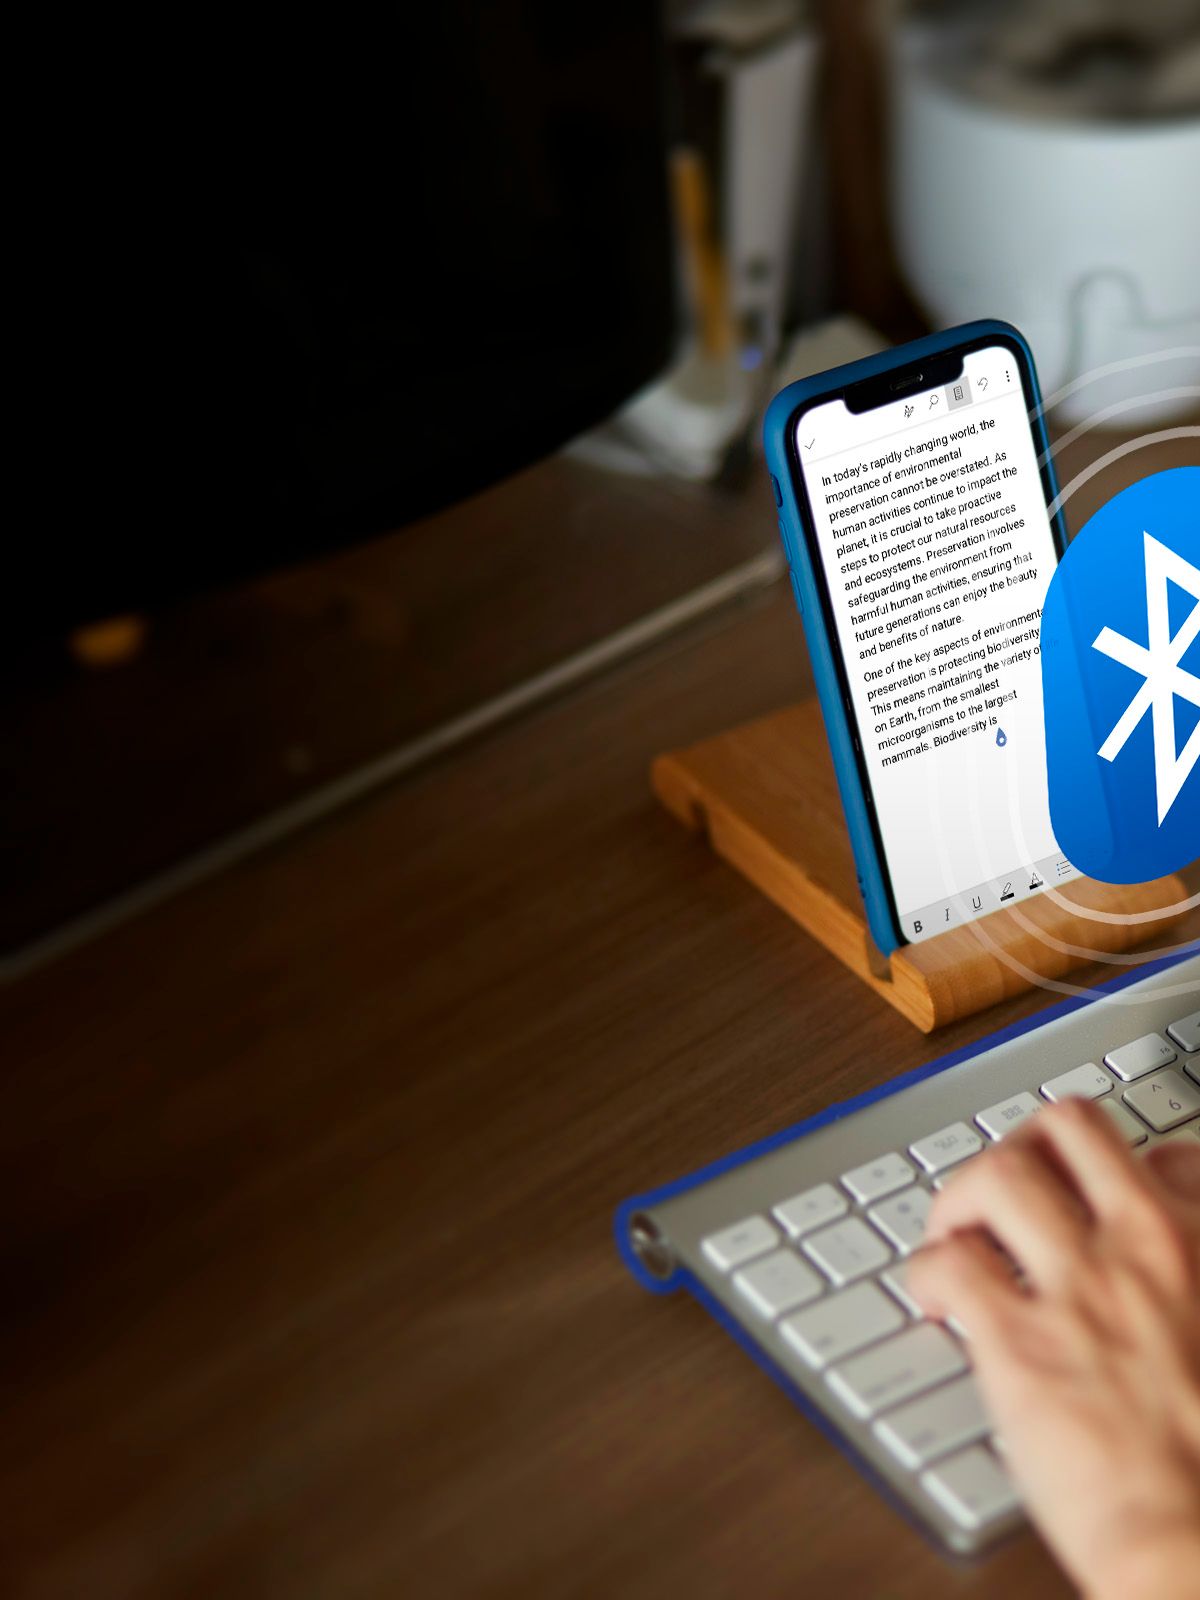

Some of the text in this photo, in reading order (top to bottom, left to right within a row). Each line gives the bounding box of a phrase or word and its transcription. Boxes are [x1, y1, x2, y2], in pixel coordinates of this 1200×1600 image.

[821, 419, 995, 486] In today's rapidly changing world, the
[825, 448, 962, 504] importance of environmental
[829, 452, 1006, 524] preservation cannot be overstated. As
[832, 466, 1017, 539] human activities continue to impact the
[836, 491, 1001, 558] planet, it is crucial to take proactive
[840, 504, 1016, 573] steps to protect our natural resources
[844, 519, 1024, 591] and ecosystems. Preservation involves
[848, 542, 1012, 608] safeguarding the environment from
[850, 552, 1032, 625] harmful human activities, ensuring that
[855, 568, 1037, 642] future generations can enjoy the beauty
[859, 615, 964, 659] and benefits of nature.
[863, 669, 883, 682] One
[885, 662, 894, 674] of
[897, 658, 912, 669] the
[914, 651, 930, 663] key
[933, 637, 969, 656] aspects
[971, 630, 981, 641] of
[867, 671, 926, 702] preservation
[928, 667, 936, 676] is
[938, 649, 986, 675] protecting
[870, 702, 891, 716] This
[893, 690, 925, 708] means
[927, 668, 982, 695] maintaining
[983, 662, 999, 673] the
[1000, 649, 1031, 666] variety
[874, 678, 999, 733] on Earth, from the smallest
[878, 690, 1017, 750] microorganisms to the largest
[881, 716, 997, 767] mammals. Biodiversity is
[914, 921, 923, 933] B
[945, 908, 950, 921] I
[973, 896, 981, 909] U
[1169, 1099, 1182, 1111] 6
